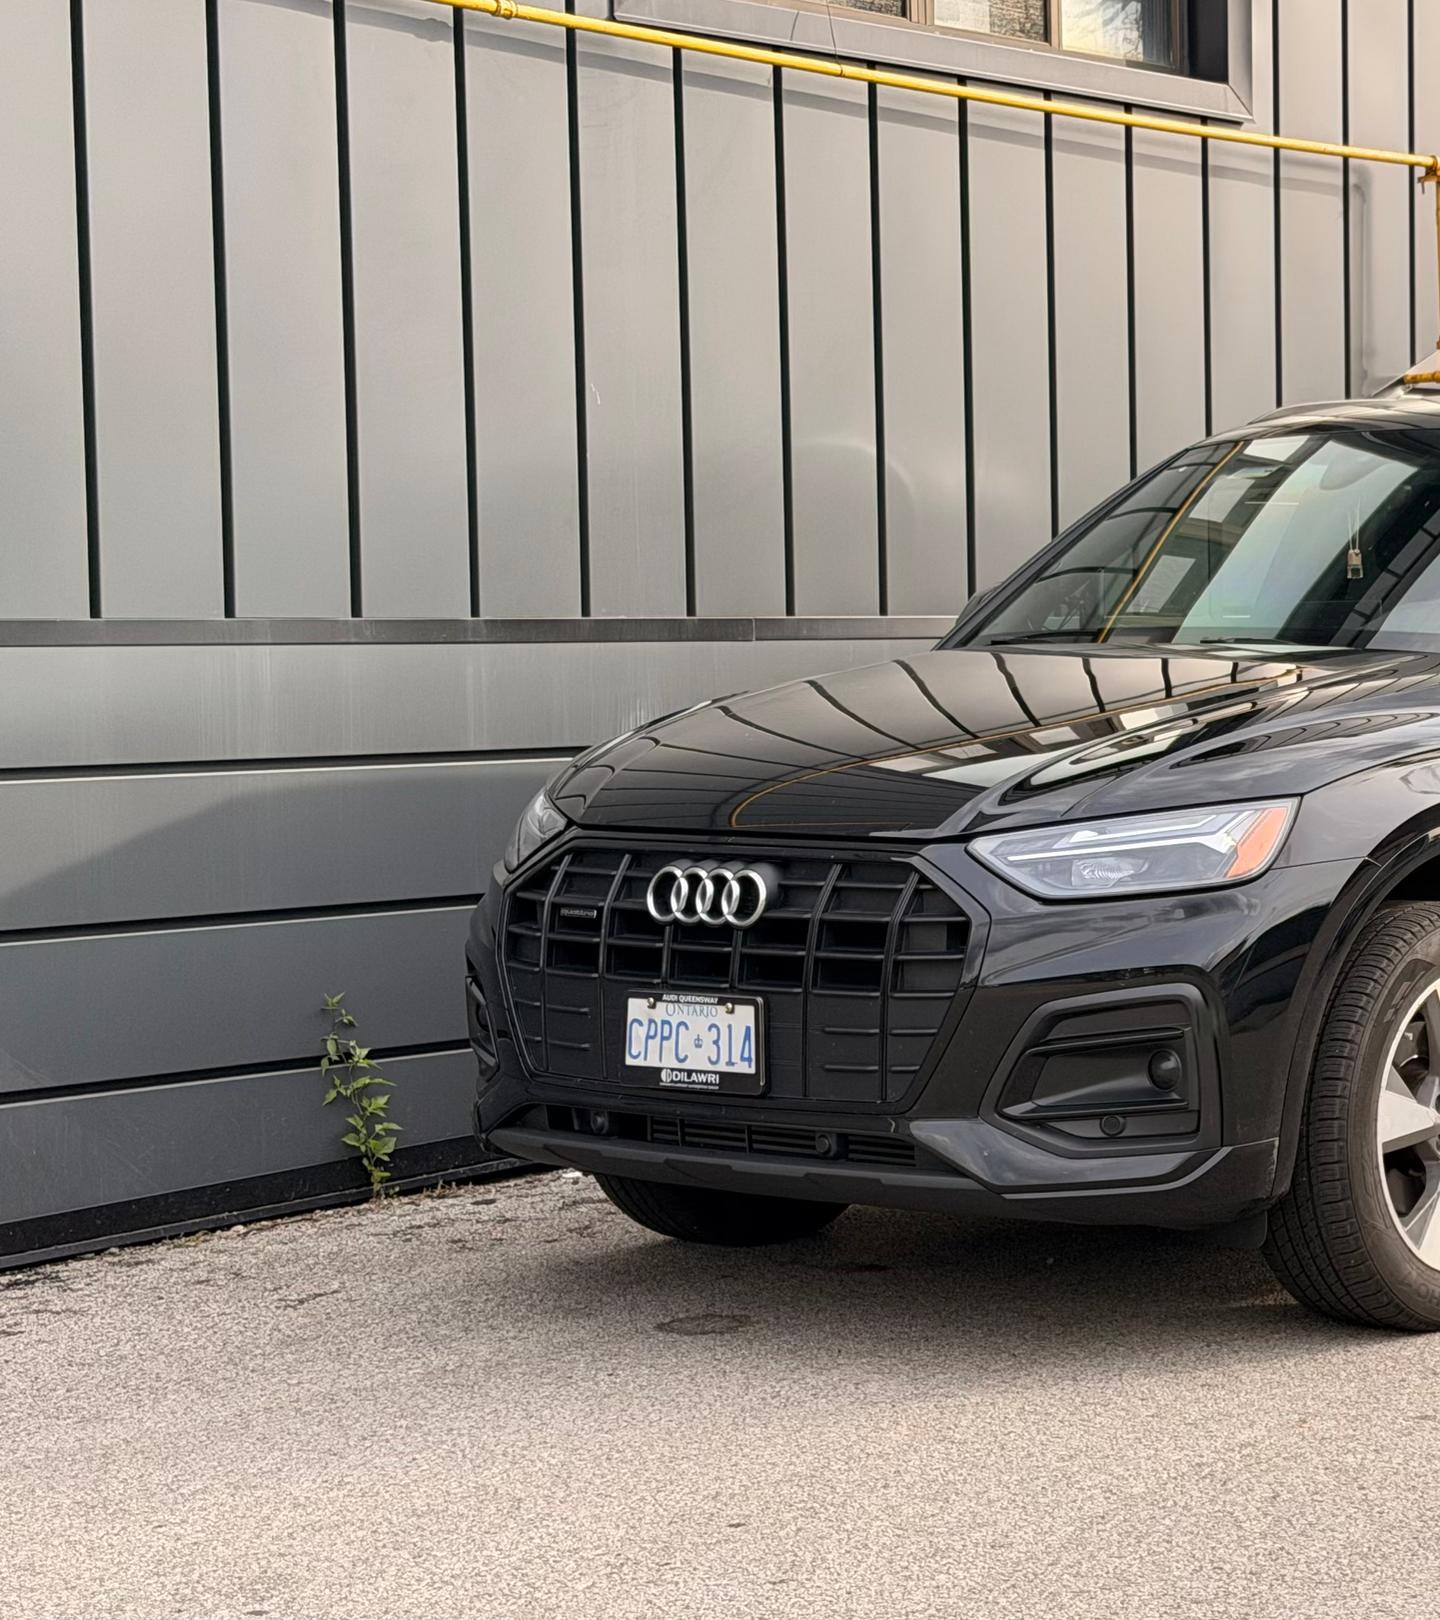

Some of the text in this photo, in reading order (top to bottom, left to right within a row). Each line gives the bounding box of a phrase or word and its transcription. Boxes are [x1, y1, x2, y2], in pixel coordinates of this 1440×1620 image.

[662, 994, 719, 1005] AUDI QUEENSWAY
[665, 1002, 718, 1017] ONTARIO
[627, 1018, 753, 1069] CPPC 314
[672, 1070, 720, 1085] DILAWRI
